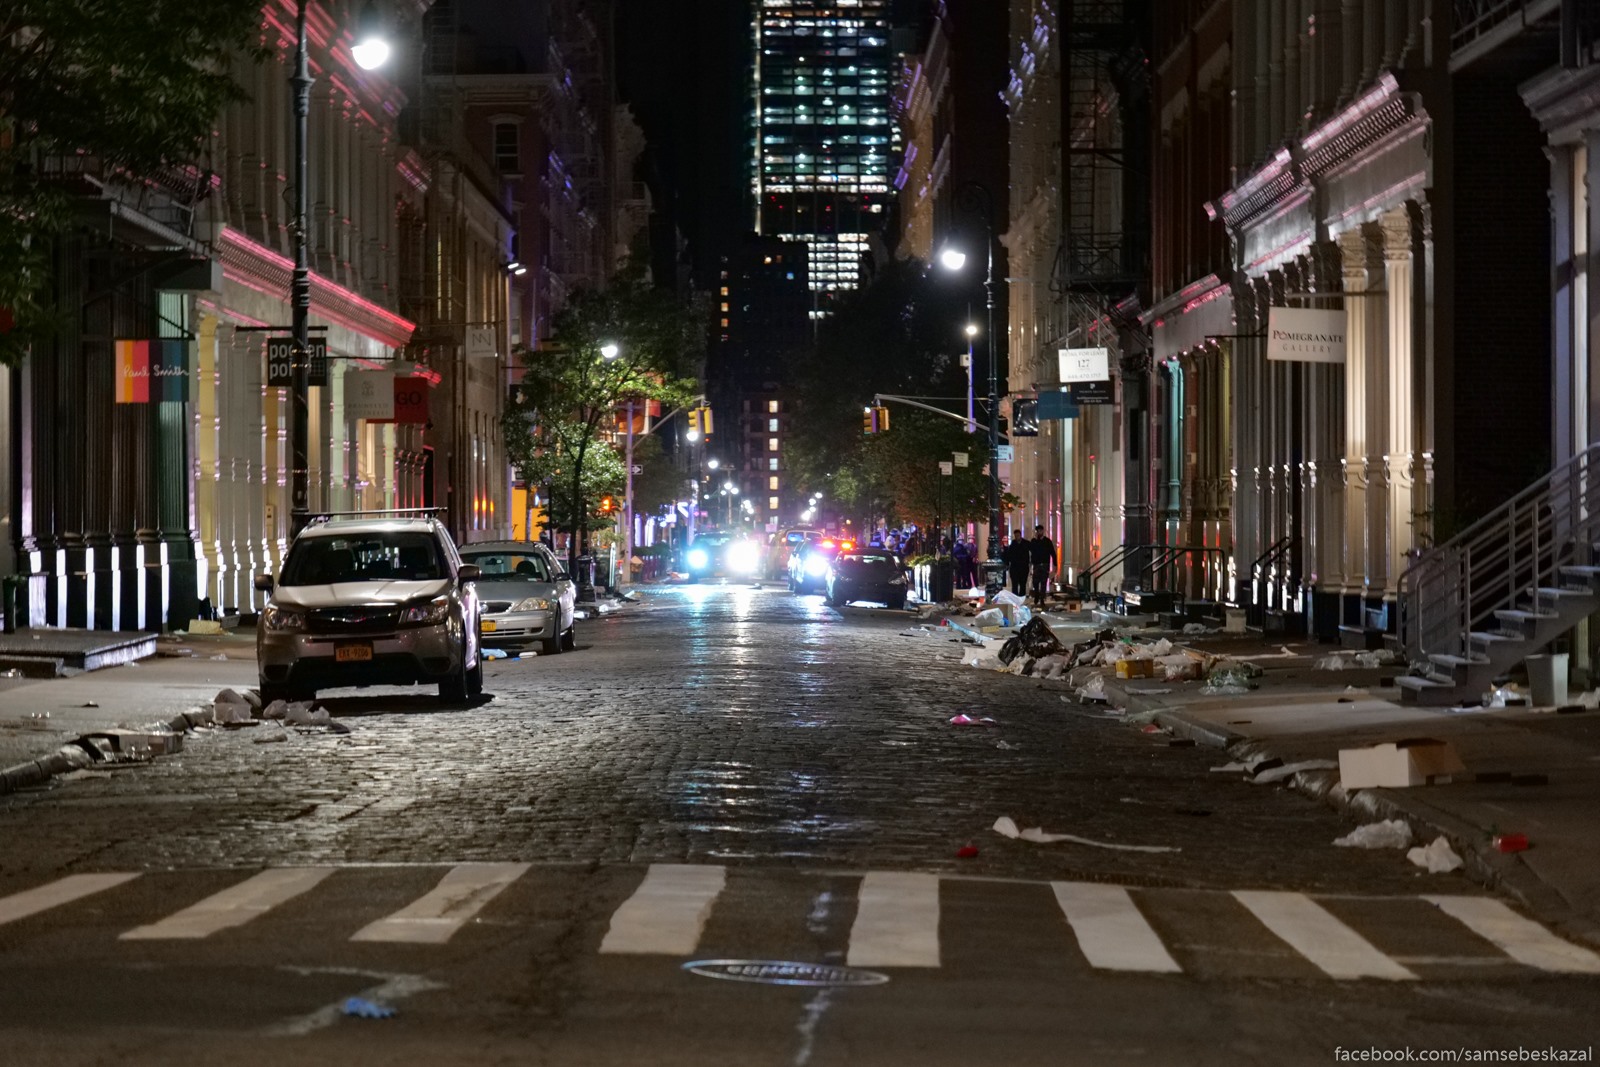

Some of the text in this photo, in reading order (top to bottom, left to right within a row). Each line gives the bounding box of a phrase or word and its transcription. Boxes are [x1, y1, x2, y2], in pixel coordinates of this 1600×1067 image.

[1273, 330, 1344, 343] POMEGRANATE
[269, 344, 325, 361] poen
[1282, 344, 1331, 352] GALLERY
[1078, 359, 1090, 367] 127
[124, 364, 189, 377] Paul Smith
